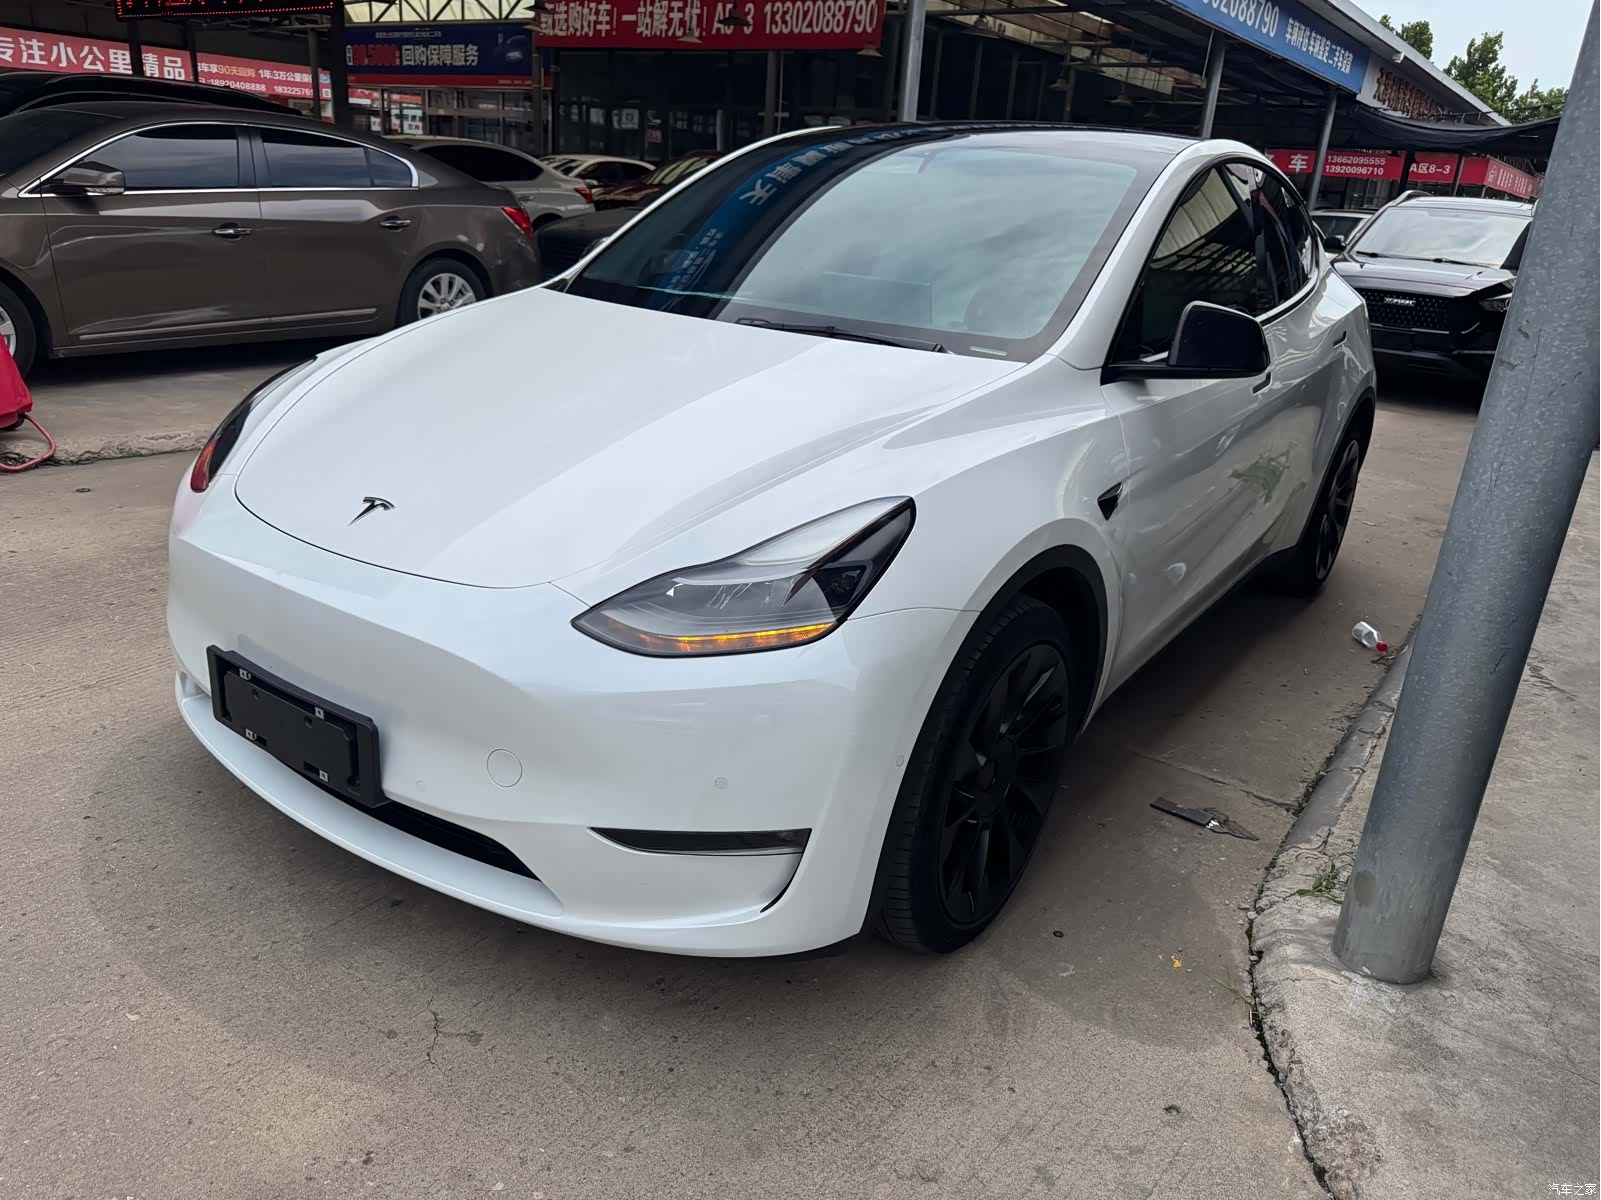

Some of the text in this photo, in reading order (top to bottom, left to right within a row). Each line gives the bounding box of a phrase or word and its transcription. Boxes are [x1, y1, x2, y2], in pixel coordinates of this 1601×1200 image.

[764, 0, 878, 34] 13302088790
[1327, 155, 1386, 165] 13662095555
[1325, 165, 1384, 175] 13920096710
[1409, 163, 1451, 174] A区8-3
